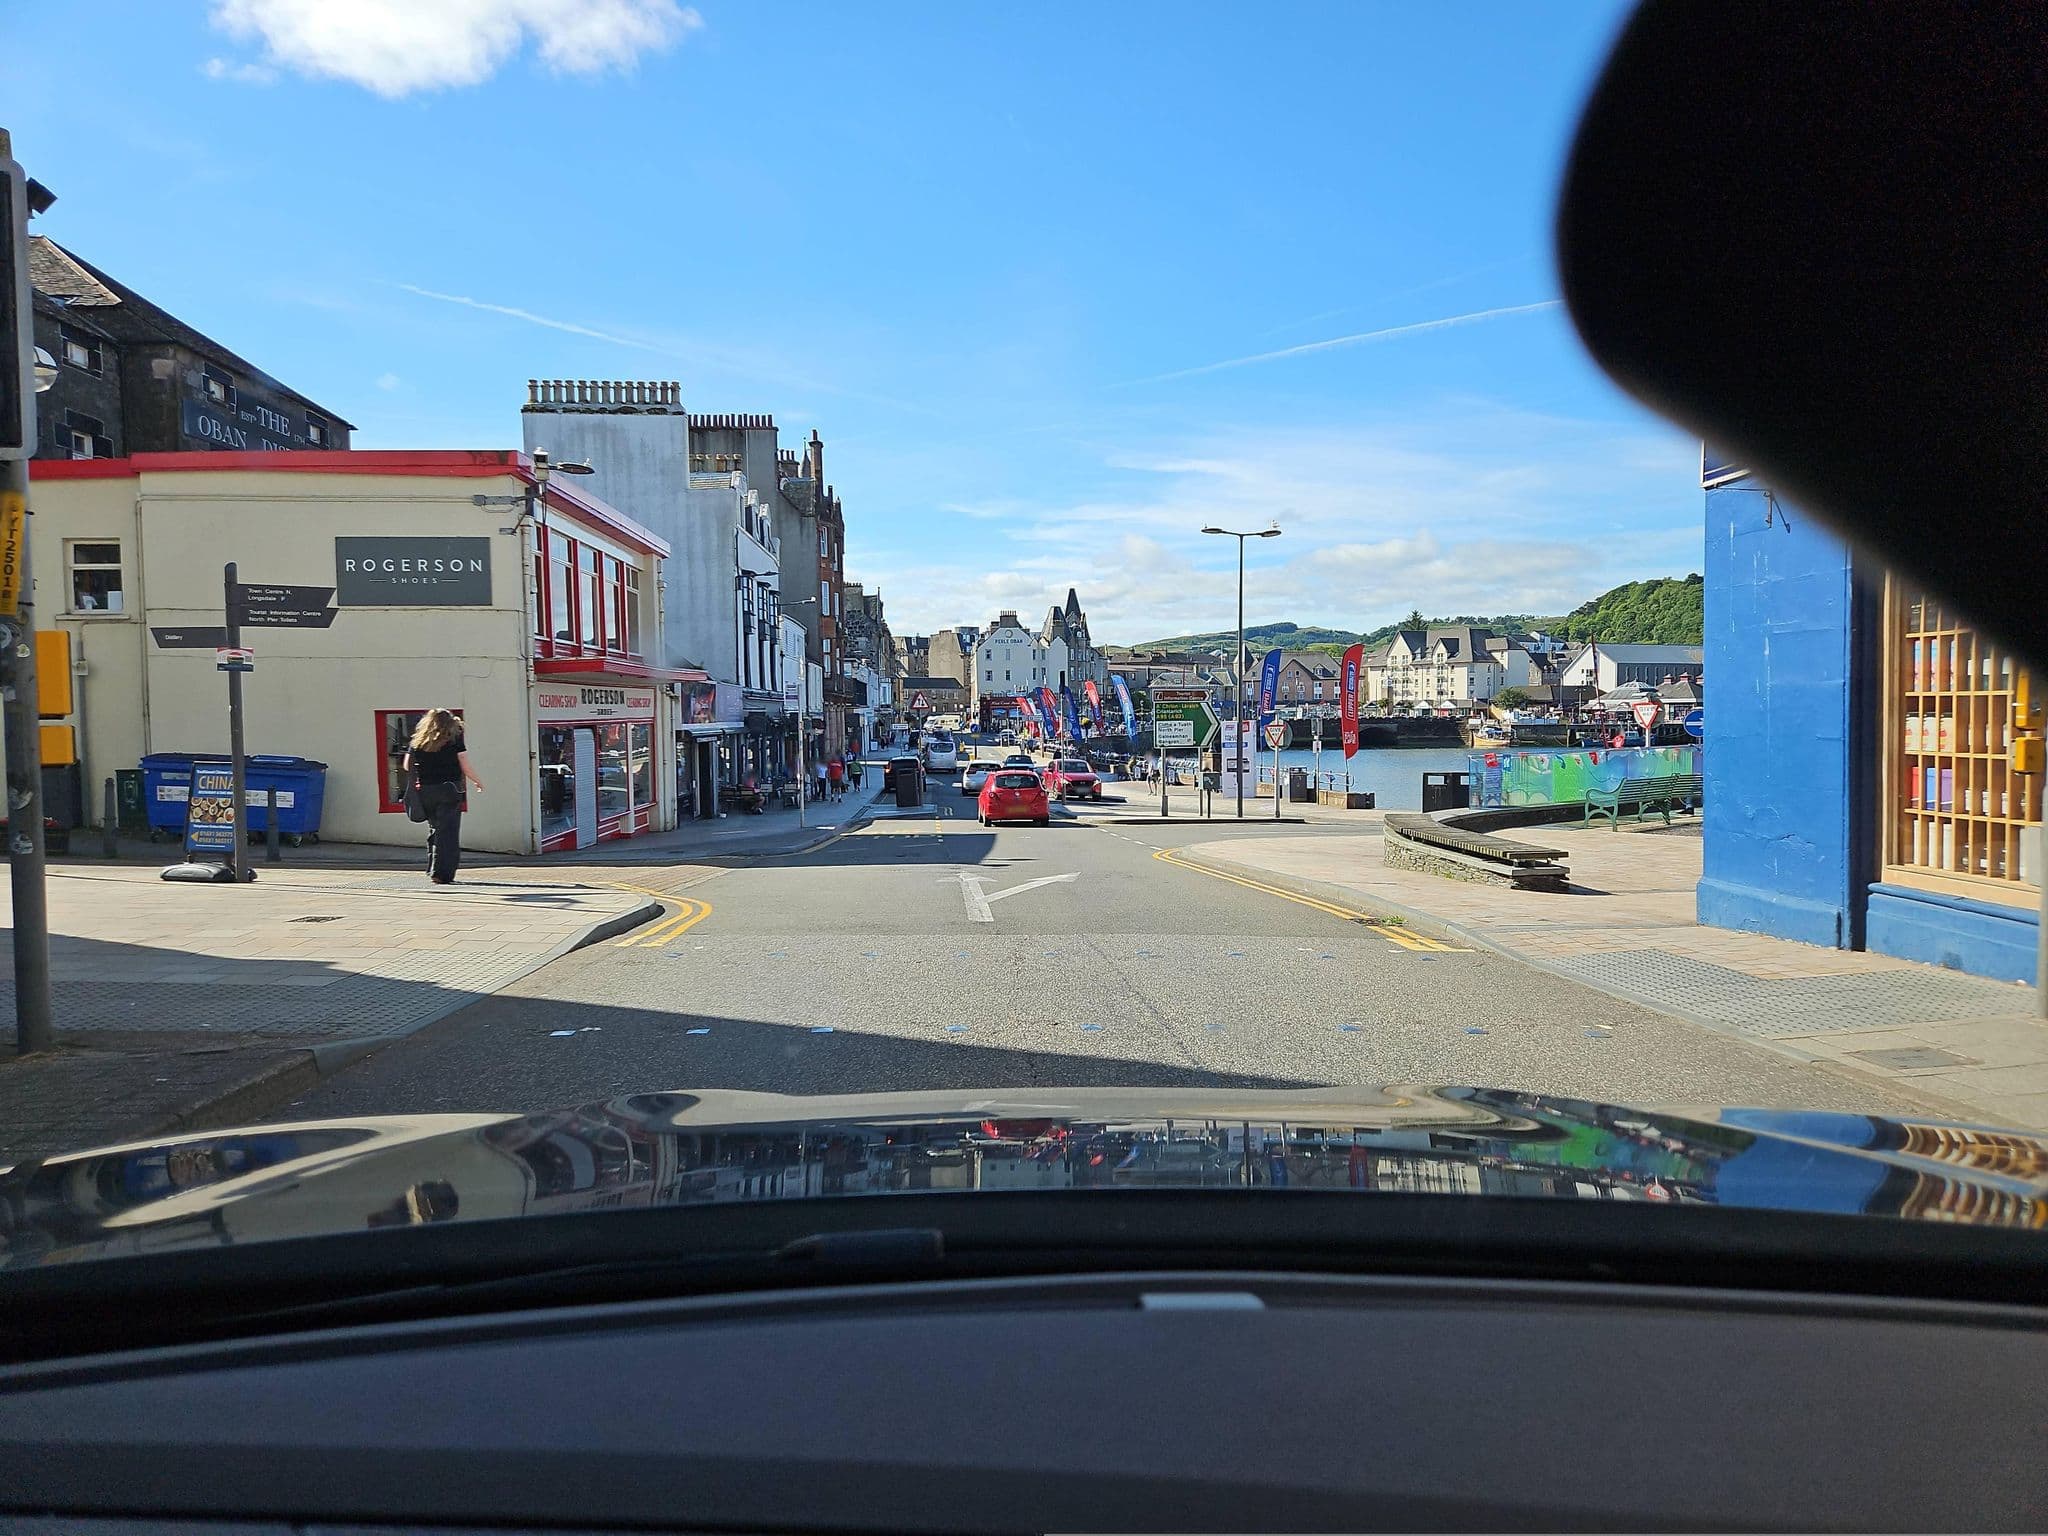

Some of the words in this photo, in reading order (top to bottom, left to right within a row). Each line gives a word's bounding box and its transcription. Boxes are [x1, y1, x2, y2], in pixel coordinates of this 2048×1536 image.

[199, 415, 248, 451] OBAN
[256, 405, 291, 437] THE
[345, 558, 483, 572] ROGERSON
[581, 688, 625, 705] ROGERSON
